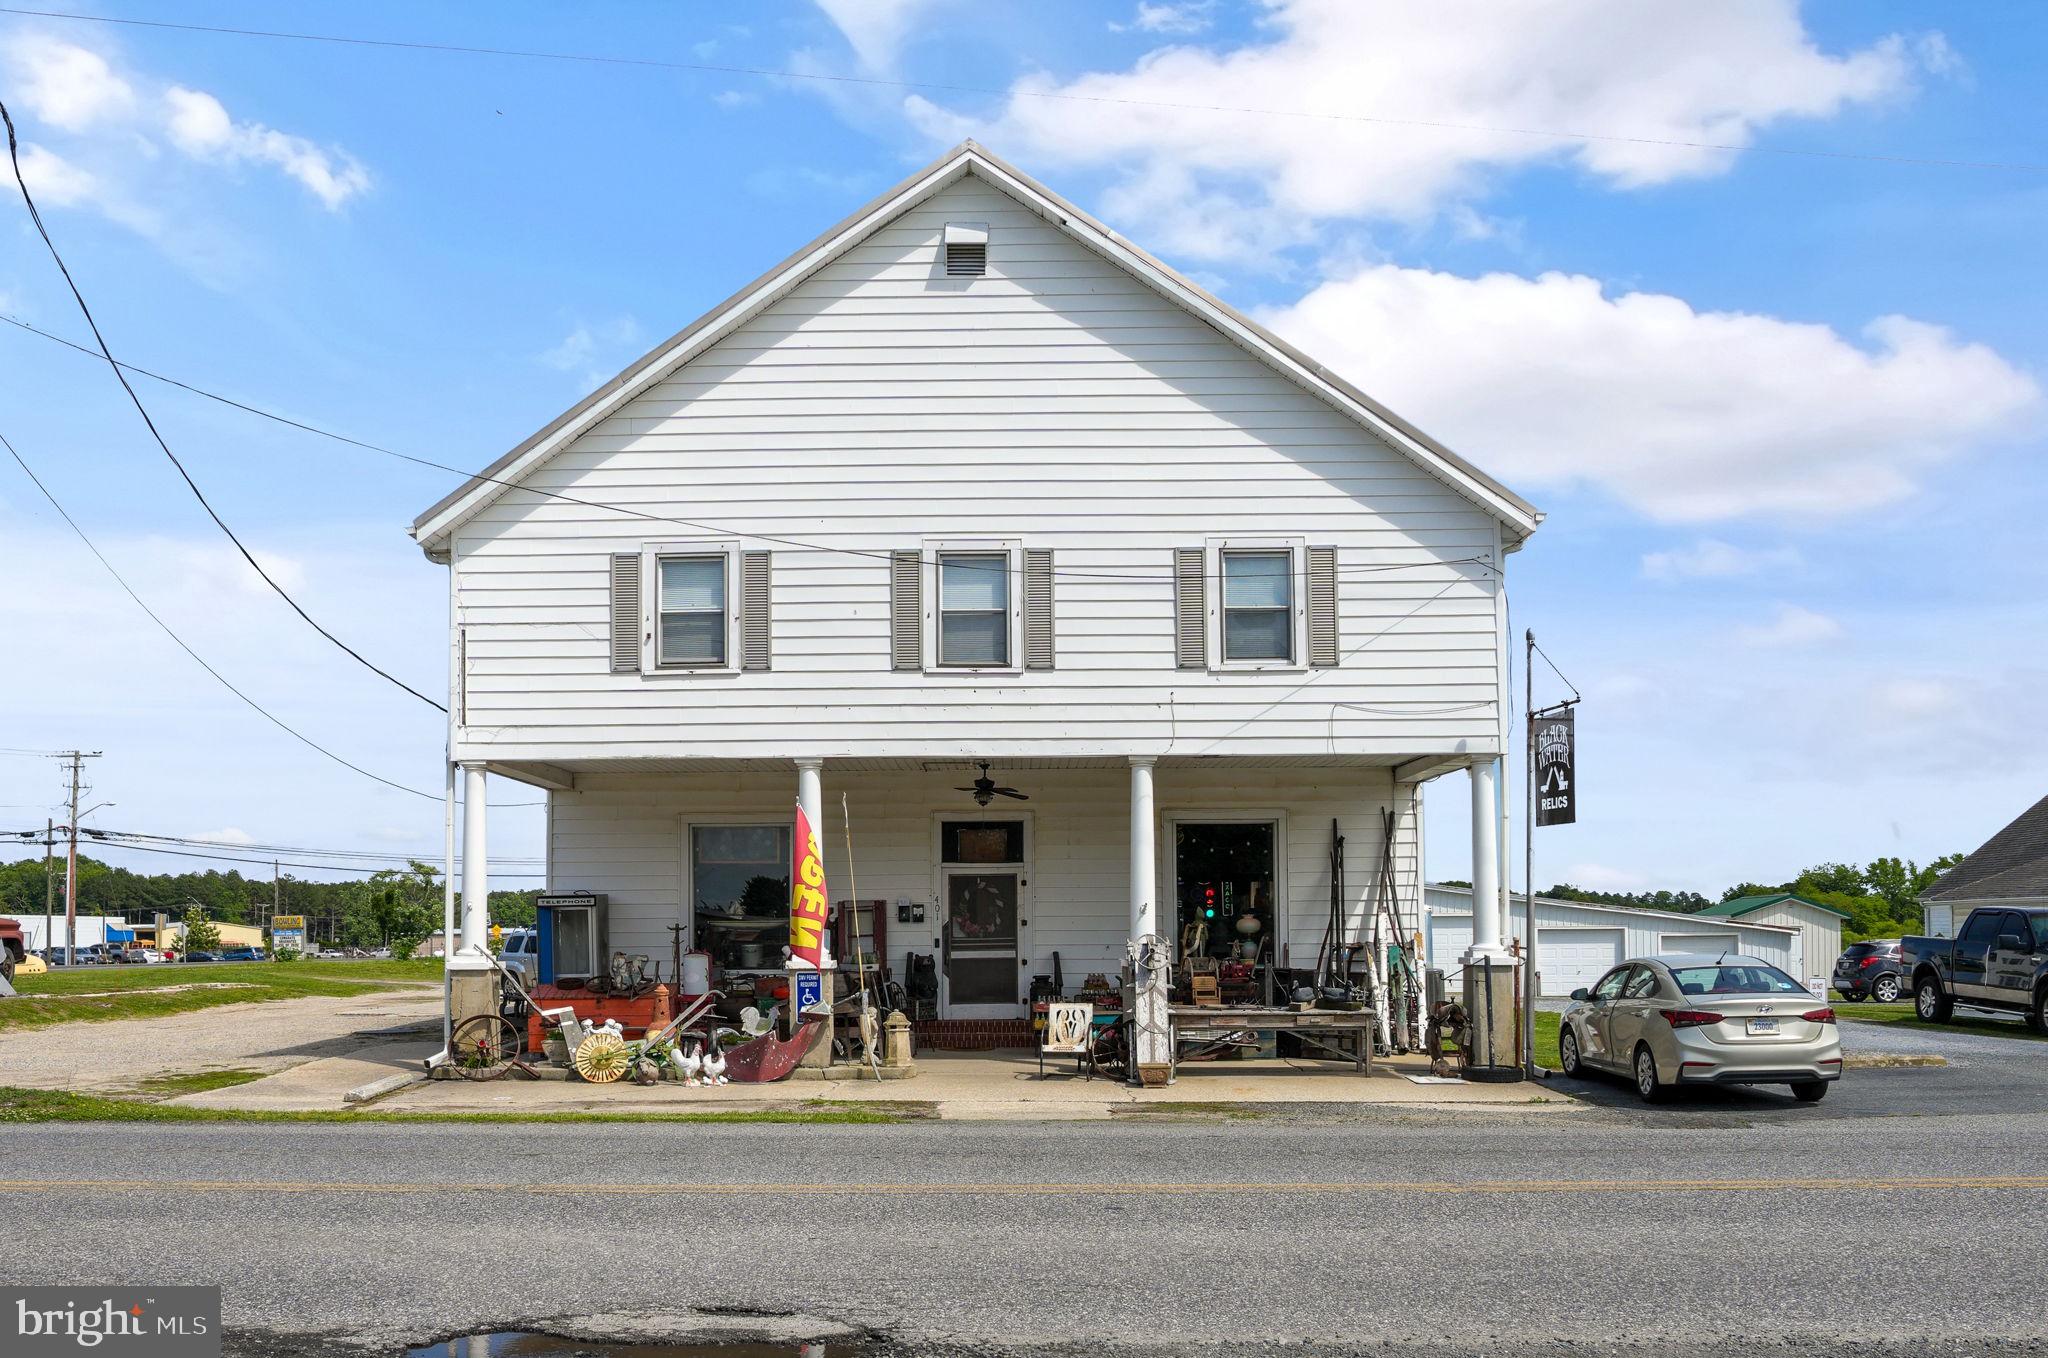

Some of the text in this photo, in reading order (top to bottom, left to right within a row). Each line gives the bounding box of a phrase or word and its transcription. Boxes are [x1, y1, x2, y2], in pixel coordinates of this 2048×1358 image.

[1538, 724, 1569, 752] BLACK
[1538, 743, 1571, 770] WATER
[1541, 795, 1568, 811] RELICS
[274, 917, 302, 925] BOWLING
[1753, 1022, 1774, 1031] 23000
